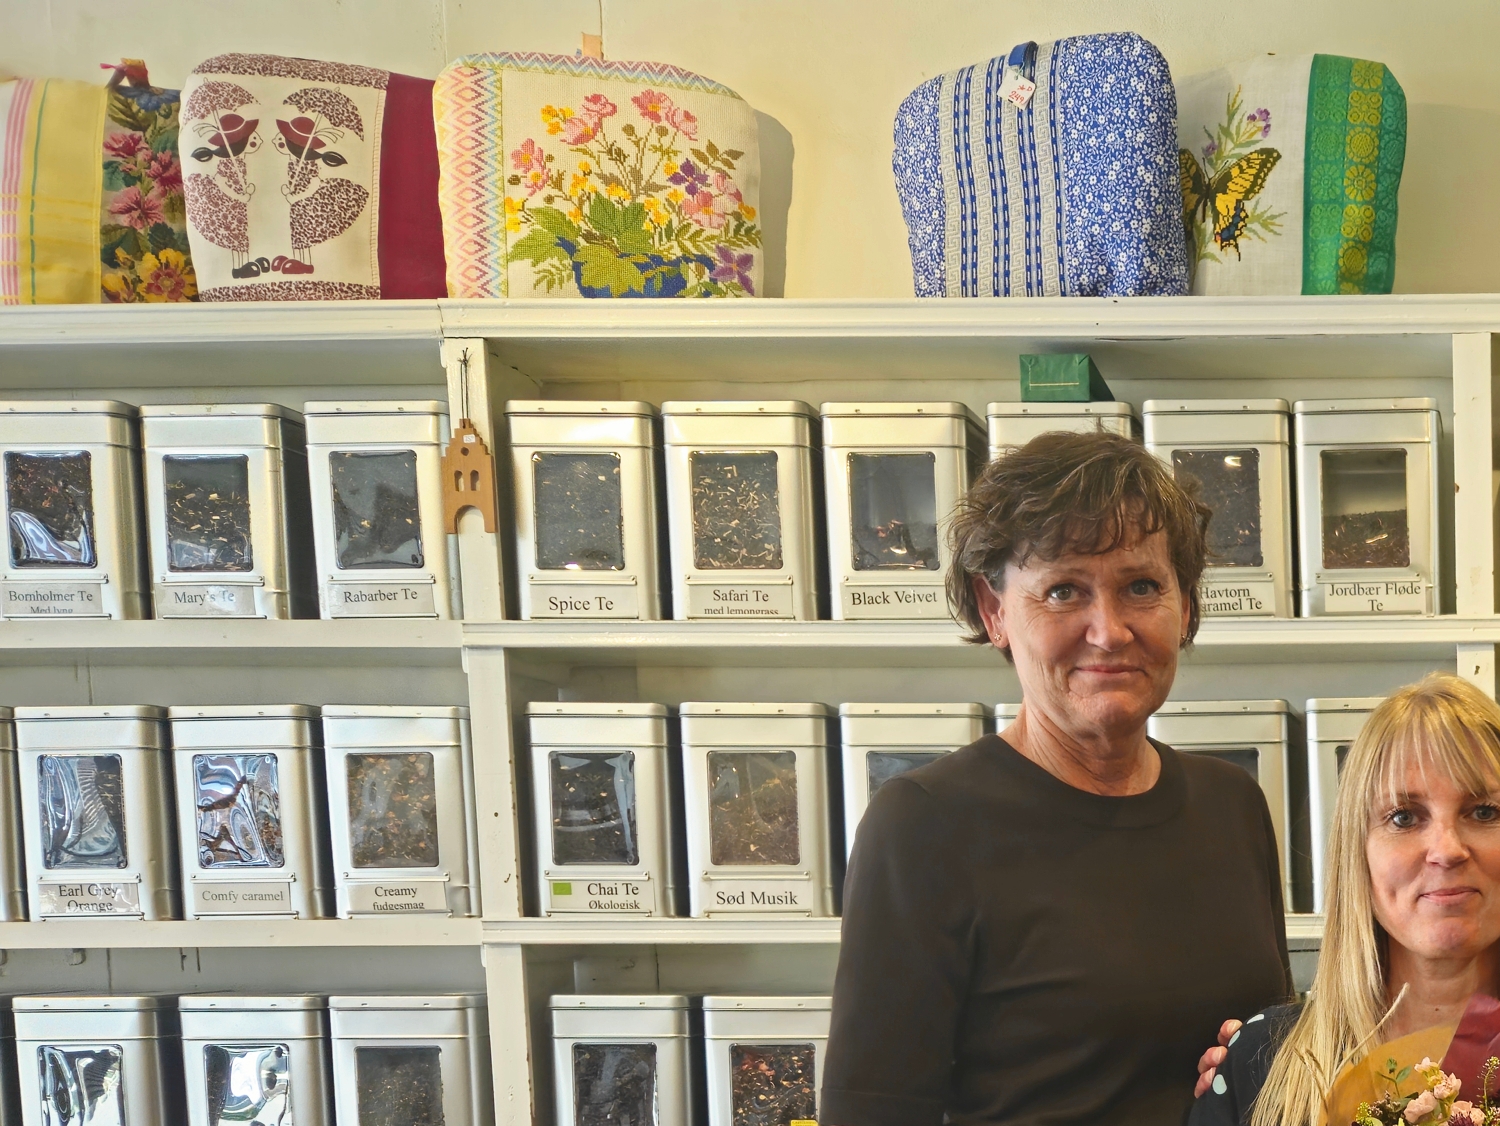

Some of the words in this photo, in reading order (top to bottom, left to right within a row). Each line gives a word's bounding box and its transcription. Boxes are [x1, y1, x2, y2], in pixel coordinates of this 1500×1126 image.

[78, 590, 93, 602] Te
[343, 589, 397, 603] Rabarber
[401, 588, 418, 601] Te
[713, 590, 750, 602] Safari
[752, 590, 769, 602] Te
[1329, 583, 1381, 597] Jordbær
[1385, 582, 1421, 596] Fløde
[174, 591, 217, 606] Mary's
[220, 591, 235, 603] Te
[852, 591, 890, 605] Black
[893, 590, 938, 604] Velvet
[1246, 598, 1263, 610] Te
[549, 597, 590, 614] Spice
[594, 597, 614, 610] Te
[704, 606, 725, 615] med
[727, 606, 779, 615] lemongrass
[1368, 600, 1384, 612] Te
[59, 884, 84, 897] Earl
[374, 886, 418, 899] Creamy
[587, 882, 621, 896] Chai
[624, 882, 640, 896] Te
[202, 889, 239, 903] Comfy
[242, 889, 284, 901] caramel
[716, 891, 745, 905] Sød
[751, 890, 798, 905] Musik
[67, 899, 113, 912] Orange
[372, 901, 424, 911] fudgesmag
[589, 899, 640, 910] Økologisk
